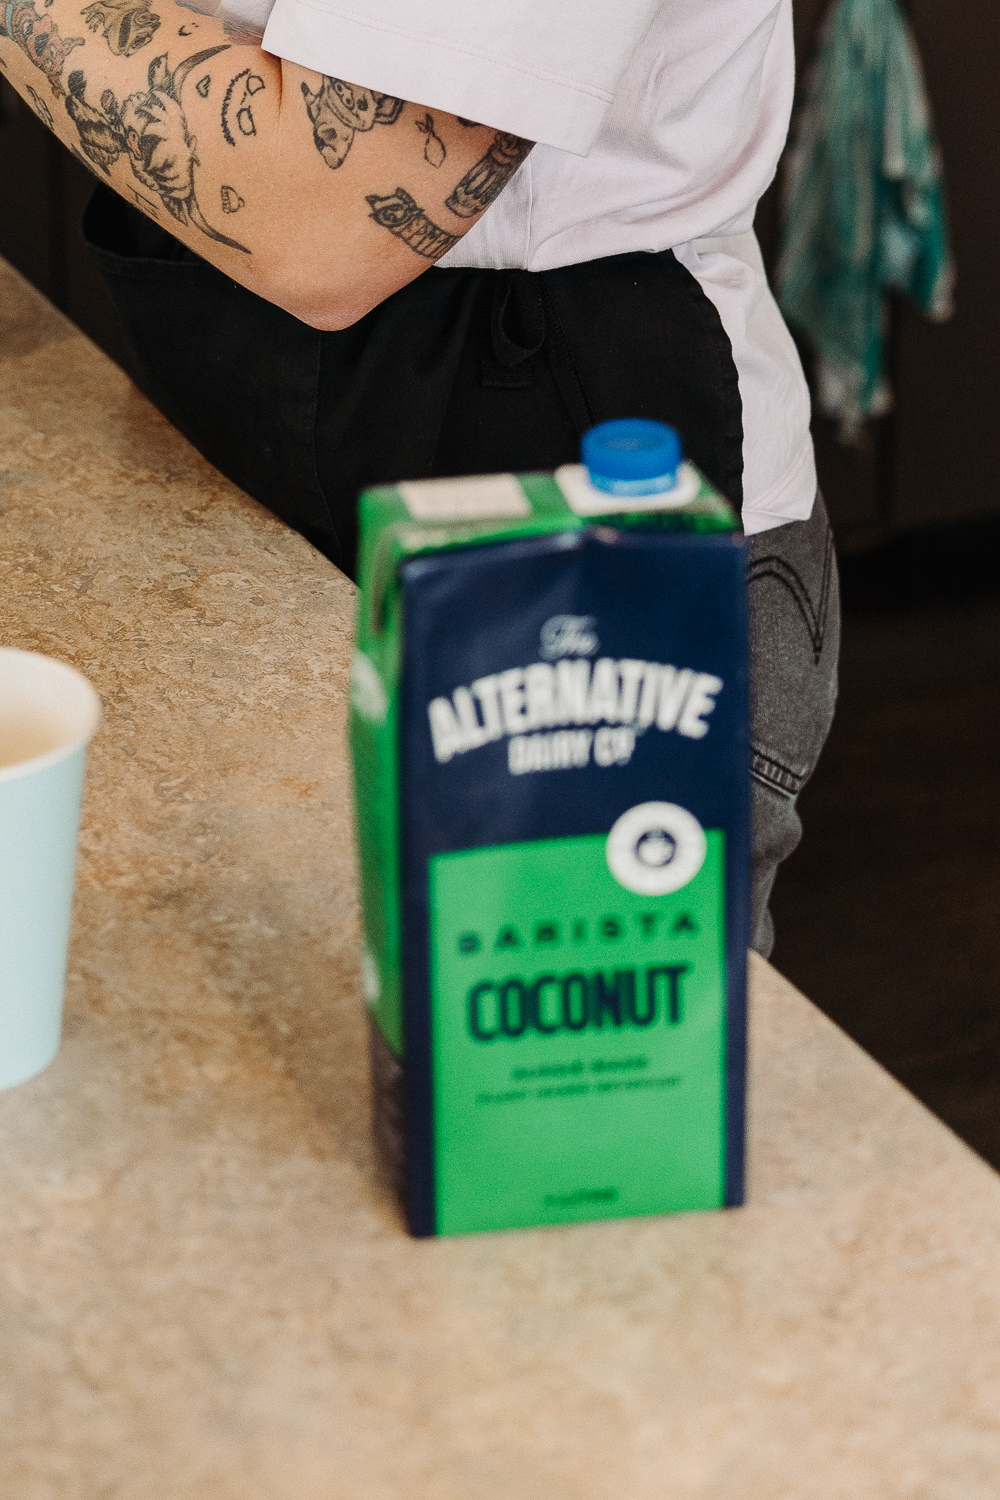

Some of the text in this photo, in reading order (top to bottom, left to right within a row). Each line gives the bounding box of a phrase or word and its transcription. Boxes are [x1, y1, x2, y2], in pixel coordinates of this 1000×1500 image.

[428, 658, 723, 763] ALTERNATIVE
[457, 910, 698, 956] BARISTA
[467, 964, 692, 1043] COCONUT
